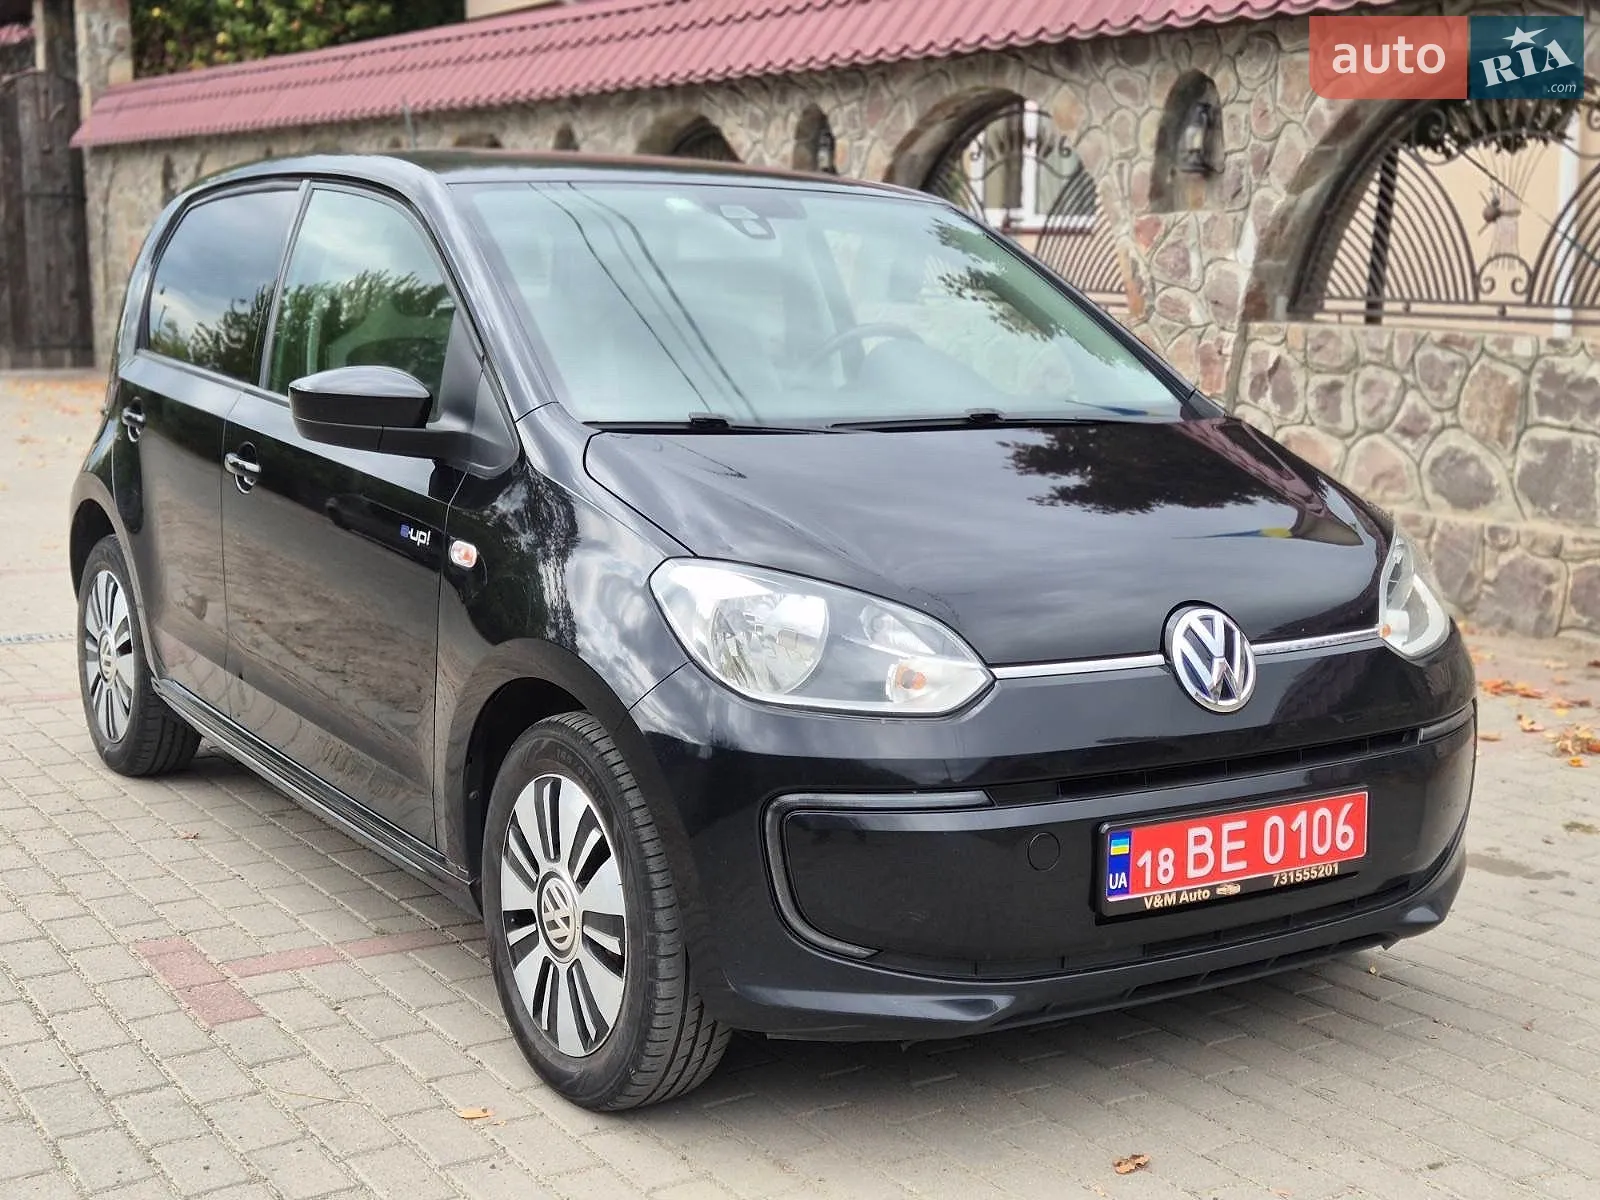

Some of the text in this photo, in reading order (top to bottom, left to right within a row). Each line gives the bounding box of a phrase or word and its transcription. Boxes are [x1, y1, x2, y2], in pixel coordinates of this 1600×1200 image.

[1136, 802, 1355, 888] 18 BE 0106
[1109, 872, 1128, 890] UA
[1273, 863, 1340, 887] 731555201
[1144, 888, 1211, 910] V&M Auto
